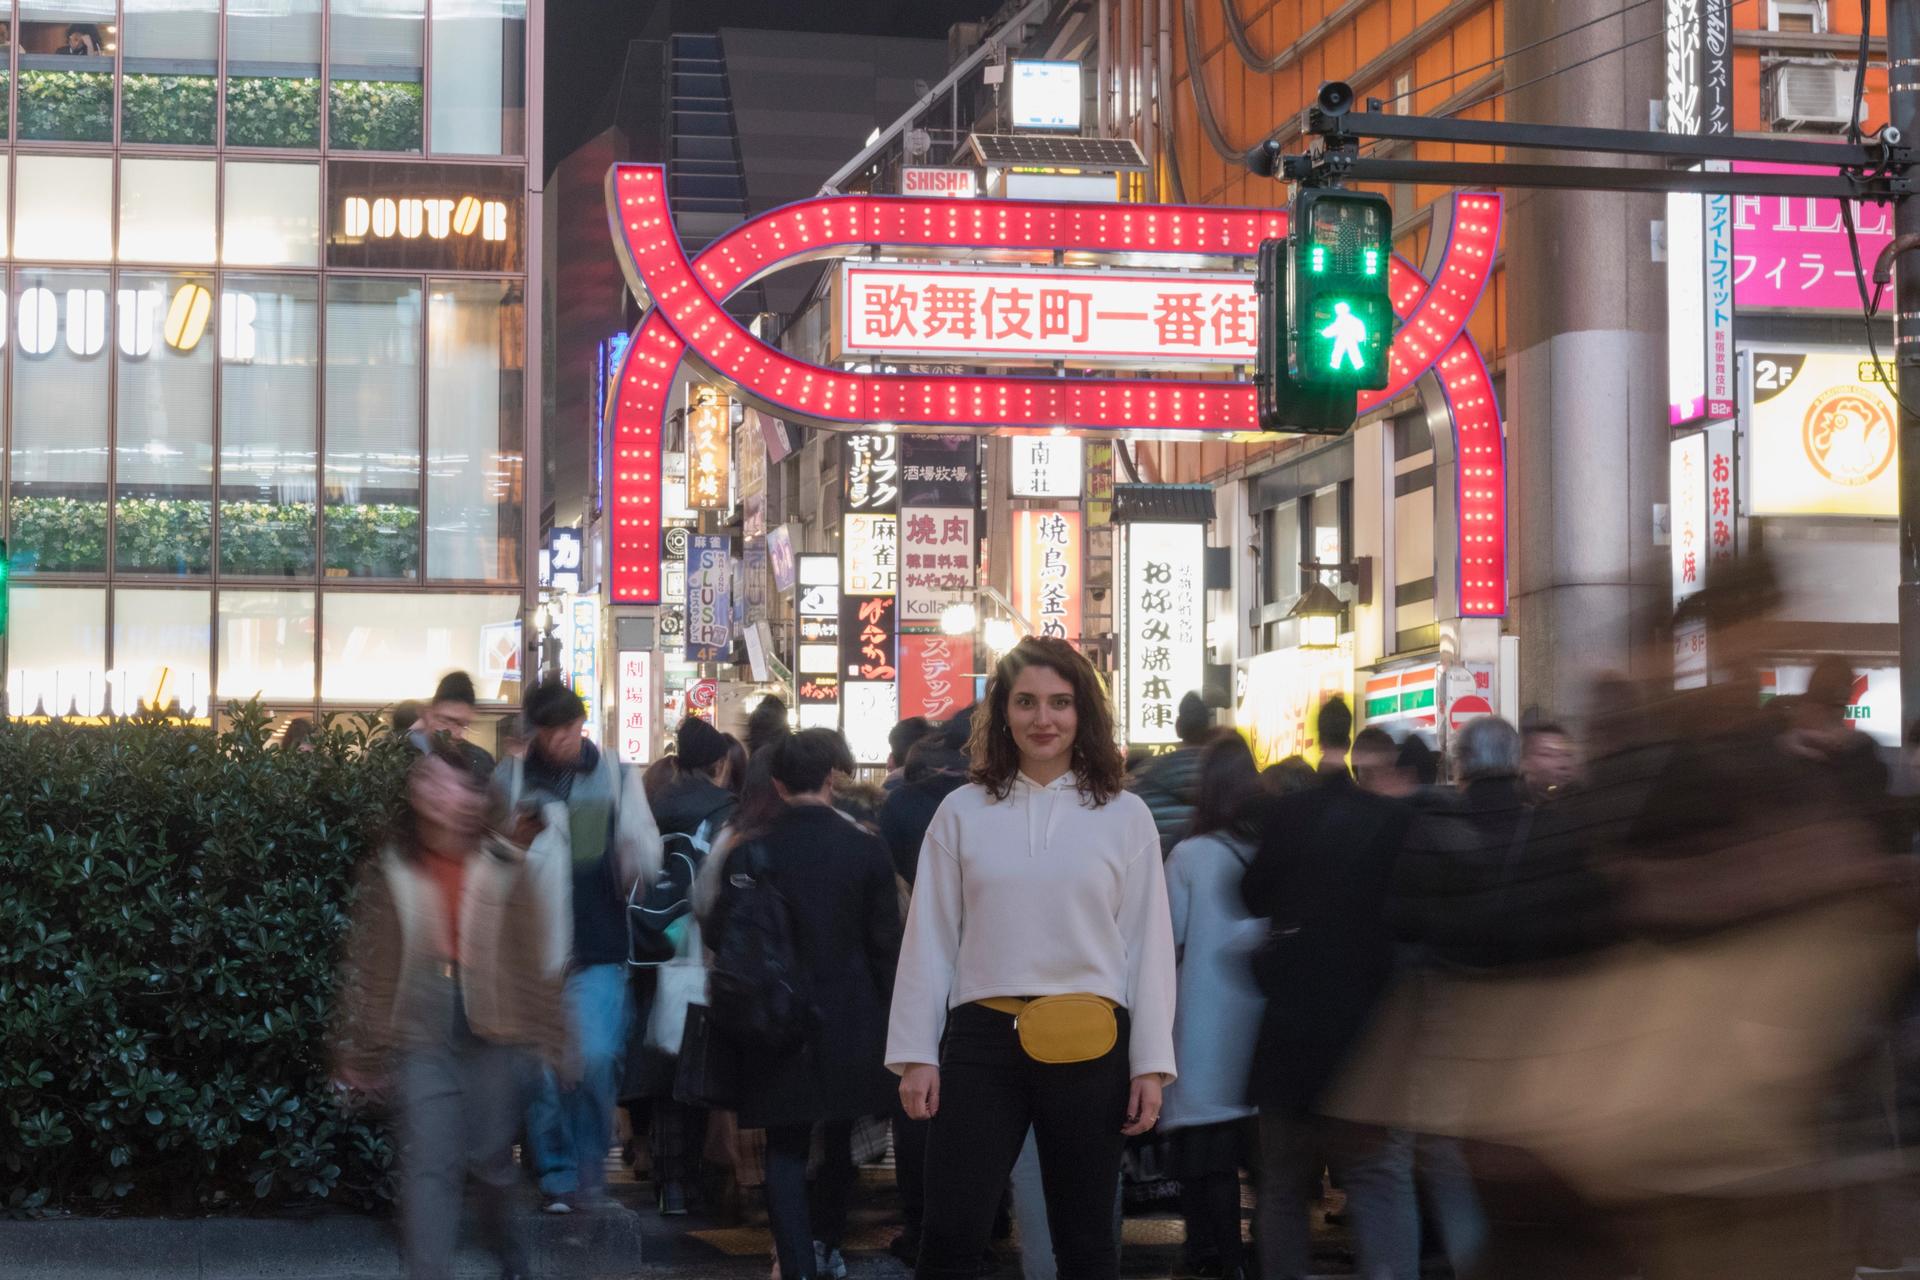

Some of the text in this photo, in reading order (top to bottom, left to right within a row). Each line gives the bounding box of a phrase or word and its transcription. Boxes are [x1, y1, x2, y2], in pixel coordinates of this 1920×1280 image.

[1708, 59, 1728, 134] スパークル
[906, 171, 969, 191] SHISHA
[344, 196, 507, 241] DOUTOR
[1734, 195, 1893, 234] FILL
[1734, 252, 1894, 291] フィラー
[0, 284, 256, 359] OUTOR
[864, 283, 1258, 347] 歌舞伎町一番街
[1756, 361, 1793, 388] 2F
[1711, 403, 1732, 415] B2F
[847, 435, 870, 508] ゼーション
[871, 434, 898, 507] リラク
[904, 465, 968, 482] 酒場牧場
[1711, 453, 1732, 550] お好み
[694, 537, 721, 548] 麻雀
[872, 517, 896, 566] 麻雀
[906, 600, 948, 614] Kolla
[697, 648, 719, 659] 4F
[921, 637, 954, 719] ステップ
[626, 660, 644, 754] 劇場通り
